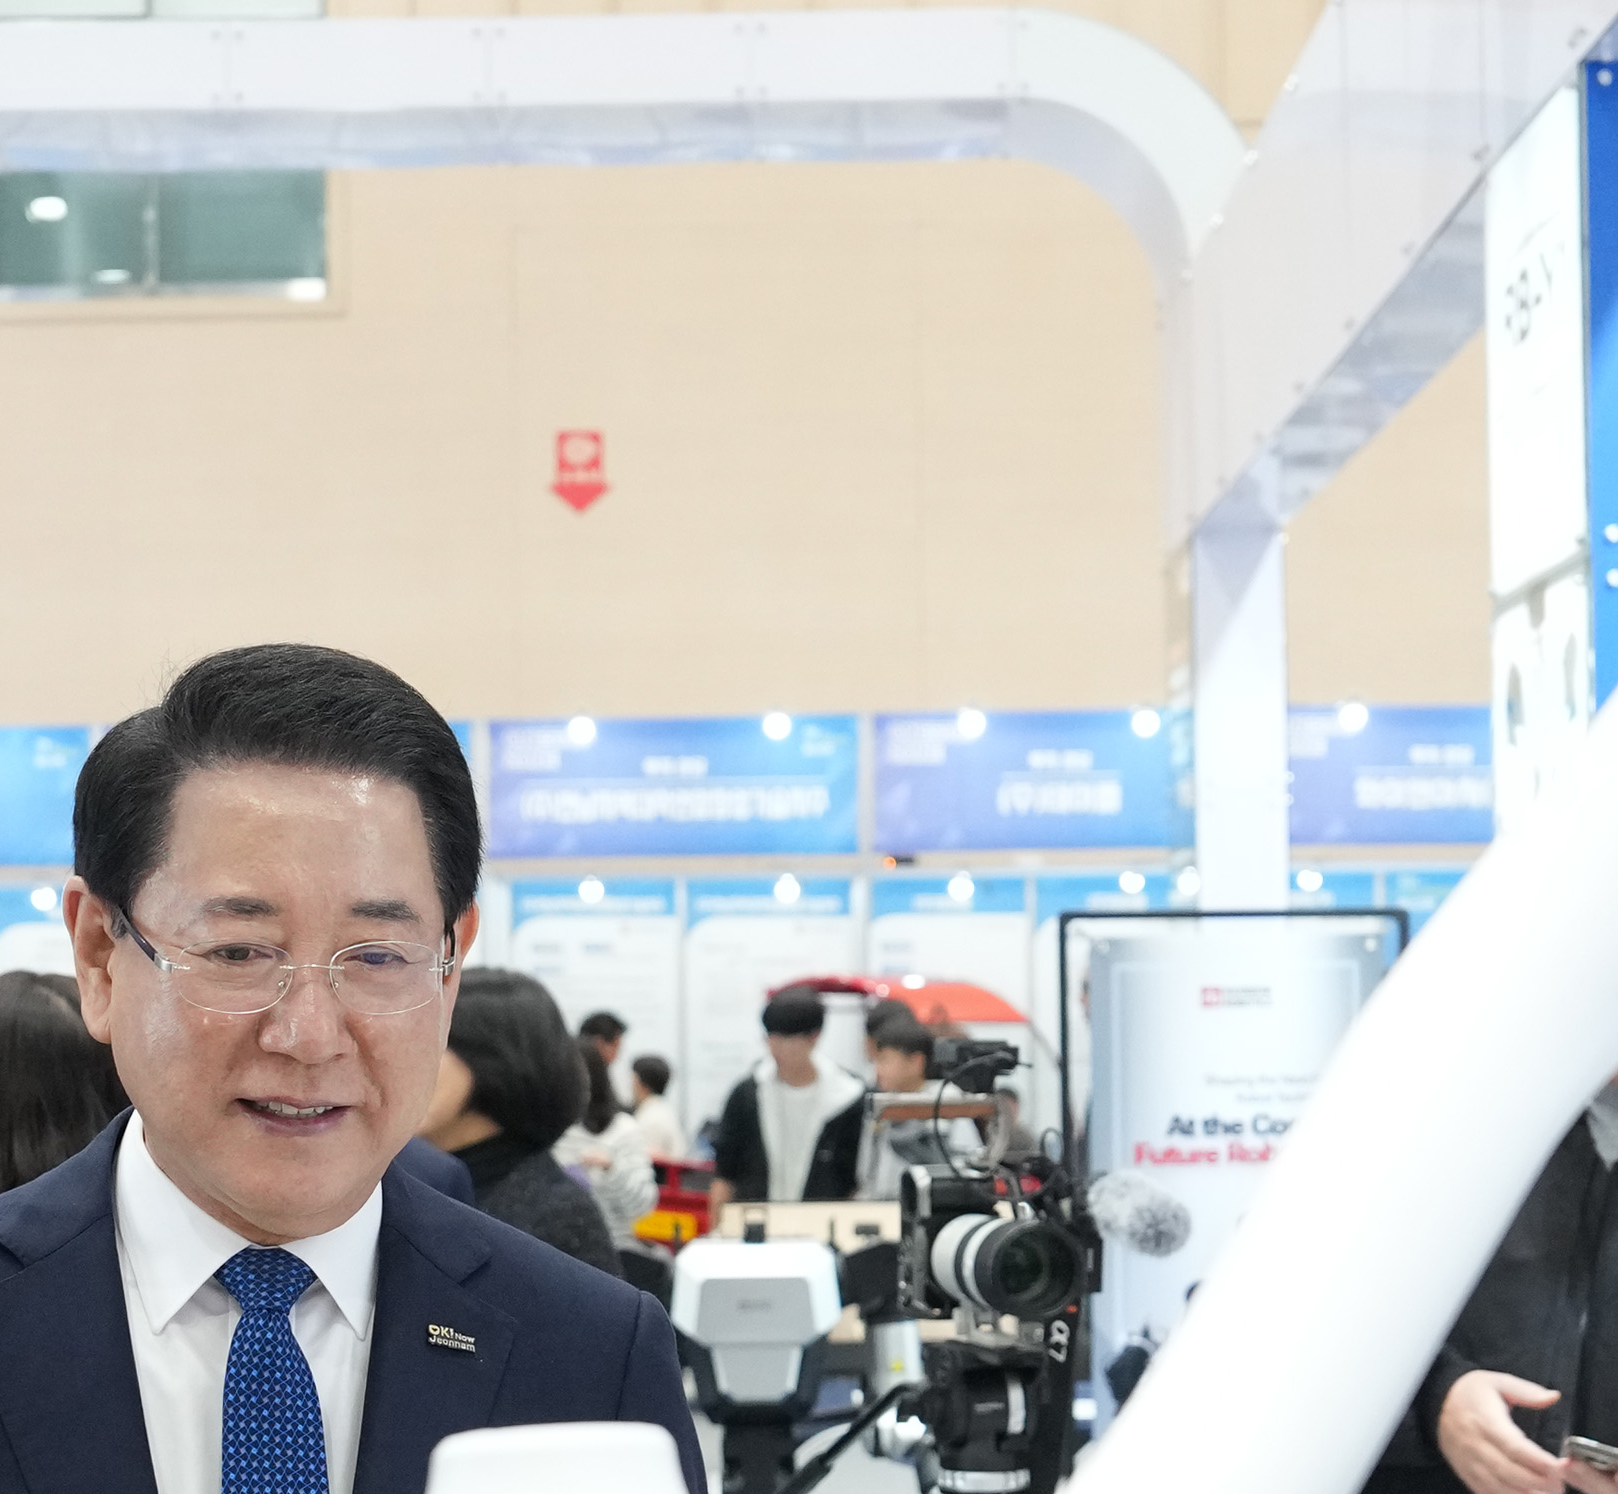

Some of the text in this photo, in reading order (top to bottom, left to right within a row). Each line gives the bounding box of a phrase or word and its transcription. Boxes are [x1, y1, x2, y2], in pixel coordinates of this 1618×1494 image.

[1167, 1115, 1195, 1136] At
[1203, 1114, 1243, 1136] the
[1134, 1143, 1218, 1165] Future
[428, 1324, 475, 1343] OK! Now
[428, 1335, 475, 1352] Jeonnam
